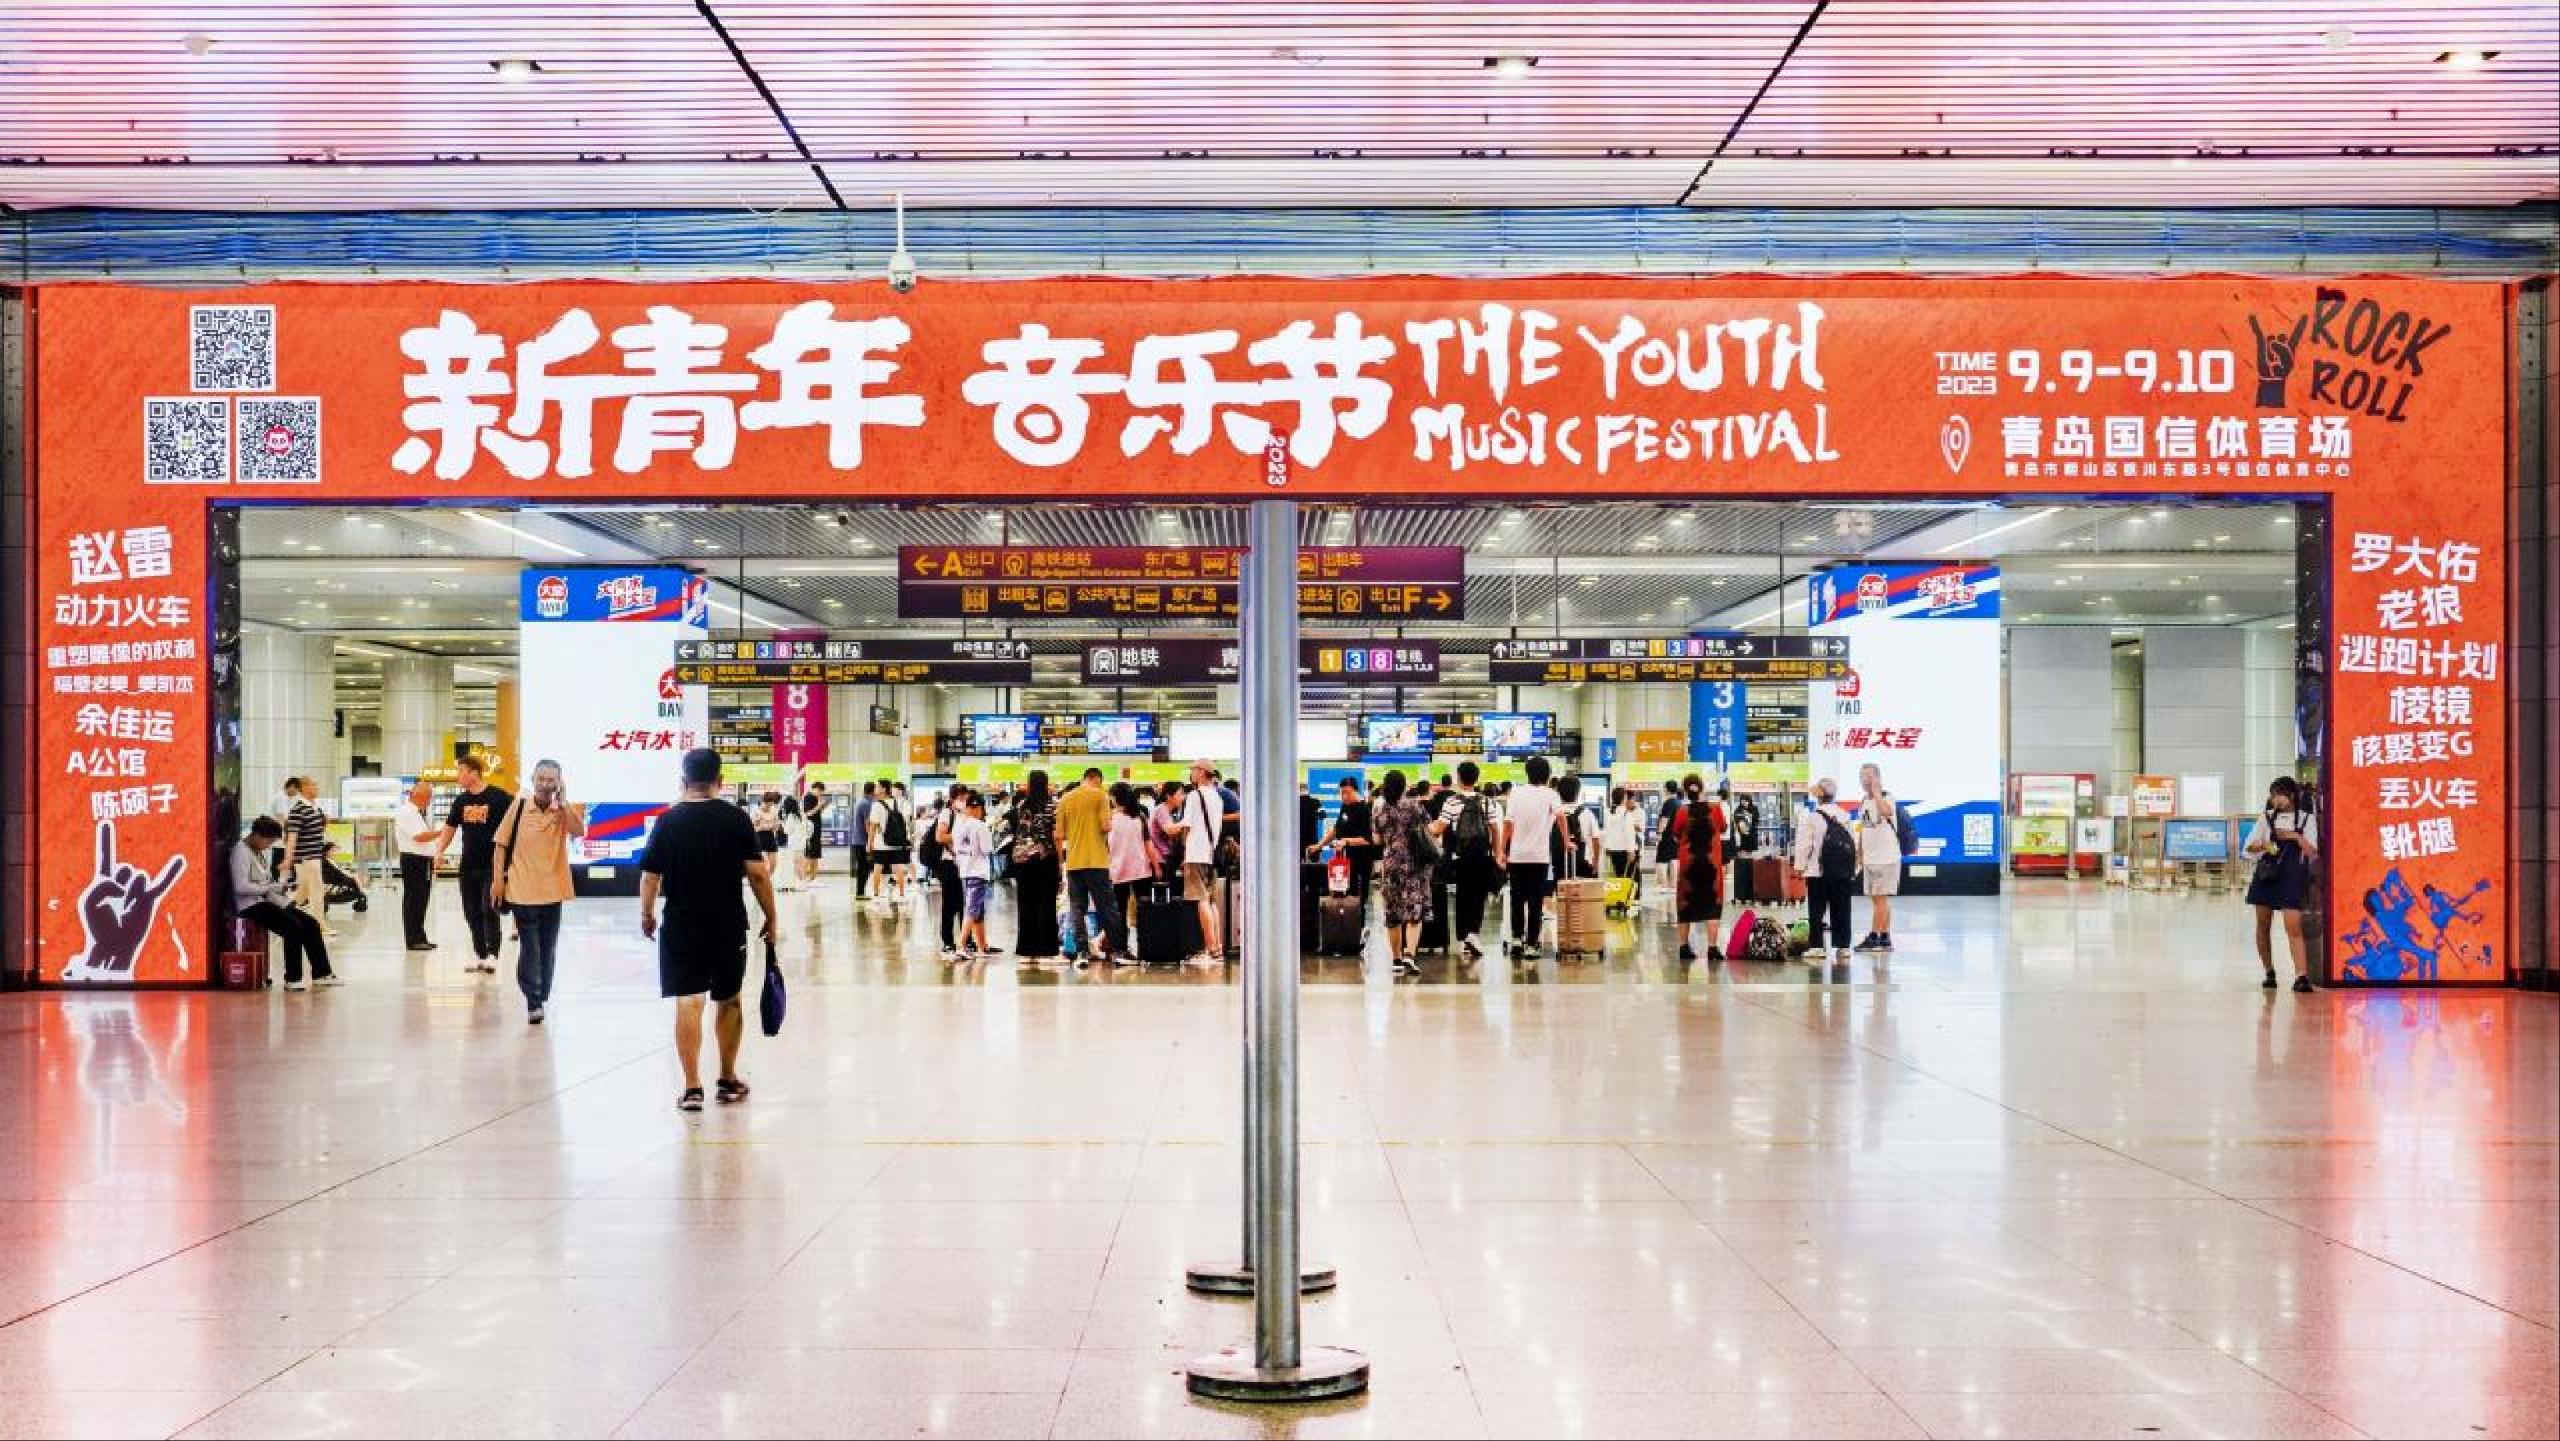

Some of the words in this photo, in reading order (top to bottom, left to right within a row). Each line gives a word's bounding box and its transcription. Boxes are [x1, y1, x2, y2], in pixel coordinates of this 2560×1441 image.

[1404, 302, 1562, 406] THE
[1577, 301, 1826, 400] YOUTH
[2309, 286, 2451, 377] ROCK
[1935, 351, 1998, 372] TIME
[2007, 349, 2235, 394] 9.9-9.10
[391, 300, 926, 479] 新青年
[962, 311, 1397, 467] 音乐节
[1935, 375, 1998, 396] 2023
[2309, 360, 2416, 424] ROLL
[1268, 433, 1287, 485] 2023
[1595, 403, 1840, 475] FESTIVAL
[2001, 415, 2352, 460] 青岛国信体育场
[69, 526, 173, 586] 赵雷
[942, 551, 963, 577] A
[963, 551, 995, 566] 出口
[2351, 532, 2481, 583] 罗大佑
[55, 594, 191, 628] 动力火车
[1371, 587, 1401, 601] 出口
[1404, 586, 1423, 612] F
[2376, 584, 2464, 630] 老狼
[1121, 648, 1160, 667] 地铁
[2339, 634, 2498, 681] 逃跑计划
[75, 703, 175, 743] 余佳运
[598, 730, 675, 750] 大汽水
[66, 748, 147, 777] A公馆
[2352, 731, 2473, 767] 核聚变G
[2379, 777, 2478, 809] 丢火车
[2379, 816, 2458, 860] 靴腿
